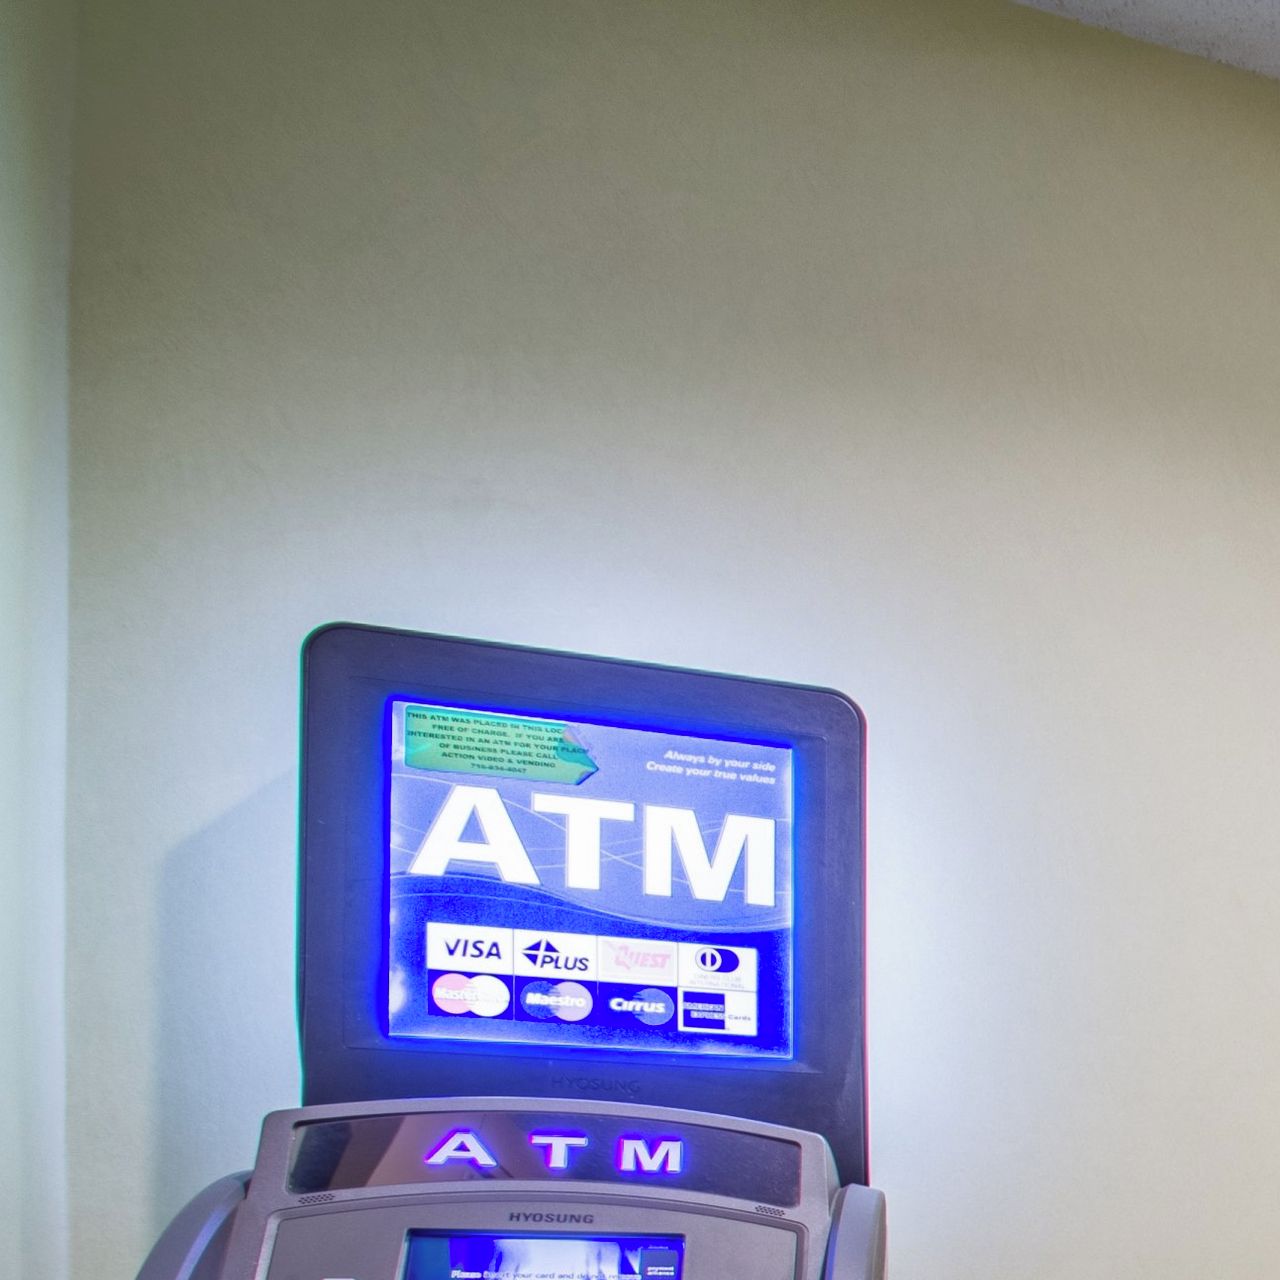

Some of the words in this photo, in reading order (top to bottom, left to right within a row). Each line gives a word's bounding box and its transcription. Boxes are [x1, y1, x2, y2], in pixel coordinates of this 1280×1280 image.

[441, 752, 475, 760] ACTION
[478, 755, 504, 763] VIDEO
[516, 759, 556, 768] VENDING
[663, 750, 705, 765] Always
[707, 755, 722, 766] by
[724, 759, 751, 768] your
[752, 761, 776, 772] side
[646, 761, 684, 774] Create
[685, 767, 712, 776] your
[713, 769, 738, 780] true
[740, 773, 776, 785] values
[407, 783, 776, 907] ATM
[445, 938, 502, 960] VISA
[540, 955, 589, 971] PLUS
[525, 992, 587, 1008] Maestro
[609, 997, 667, 1014] Cirrus
[552, 1076, 641, 1092] HYOSUNG
[424, 1130, 684, 1172] ATM
[509, 1212, 595, 1224] HYOSUNG
